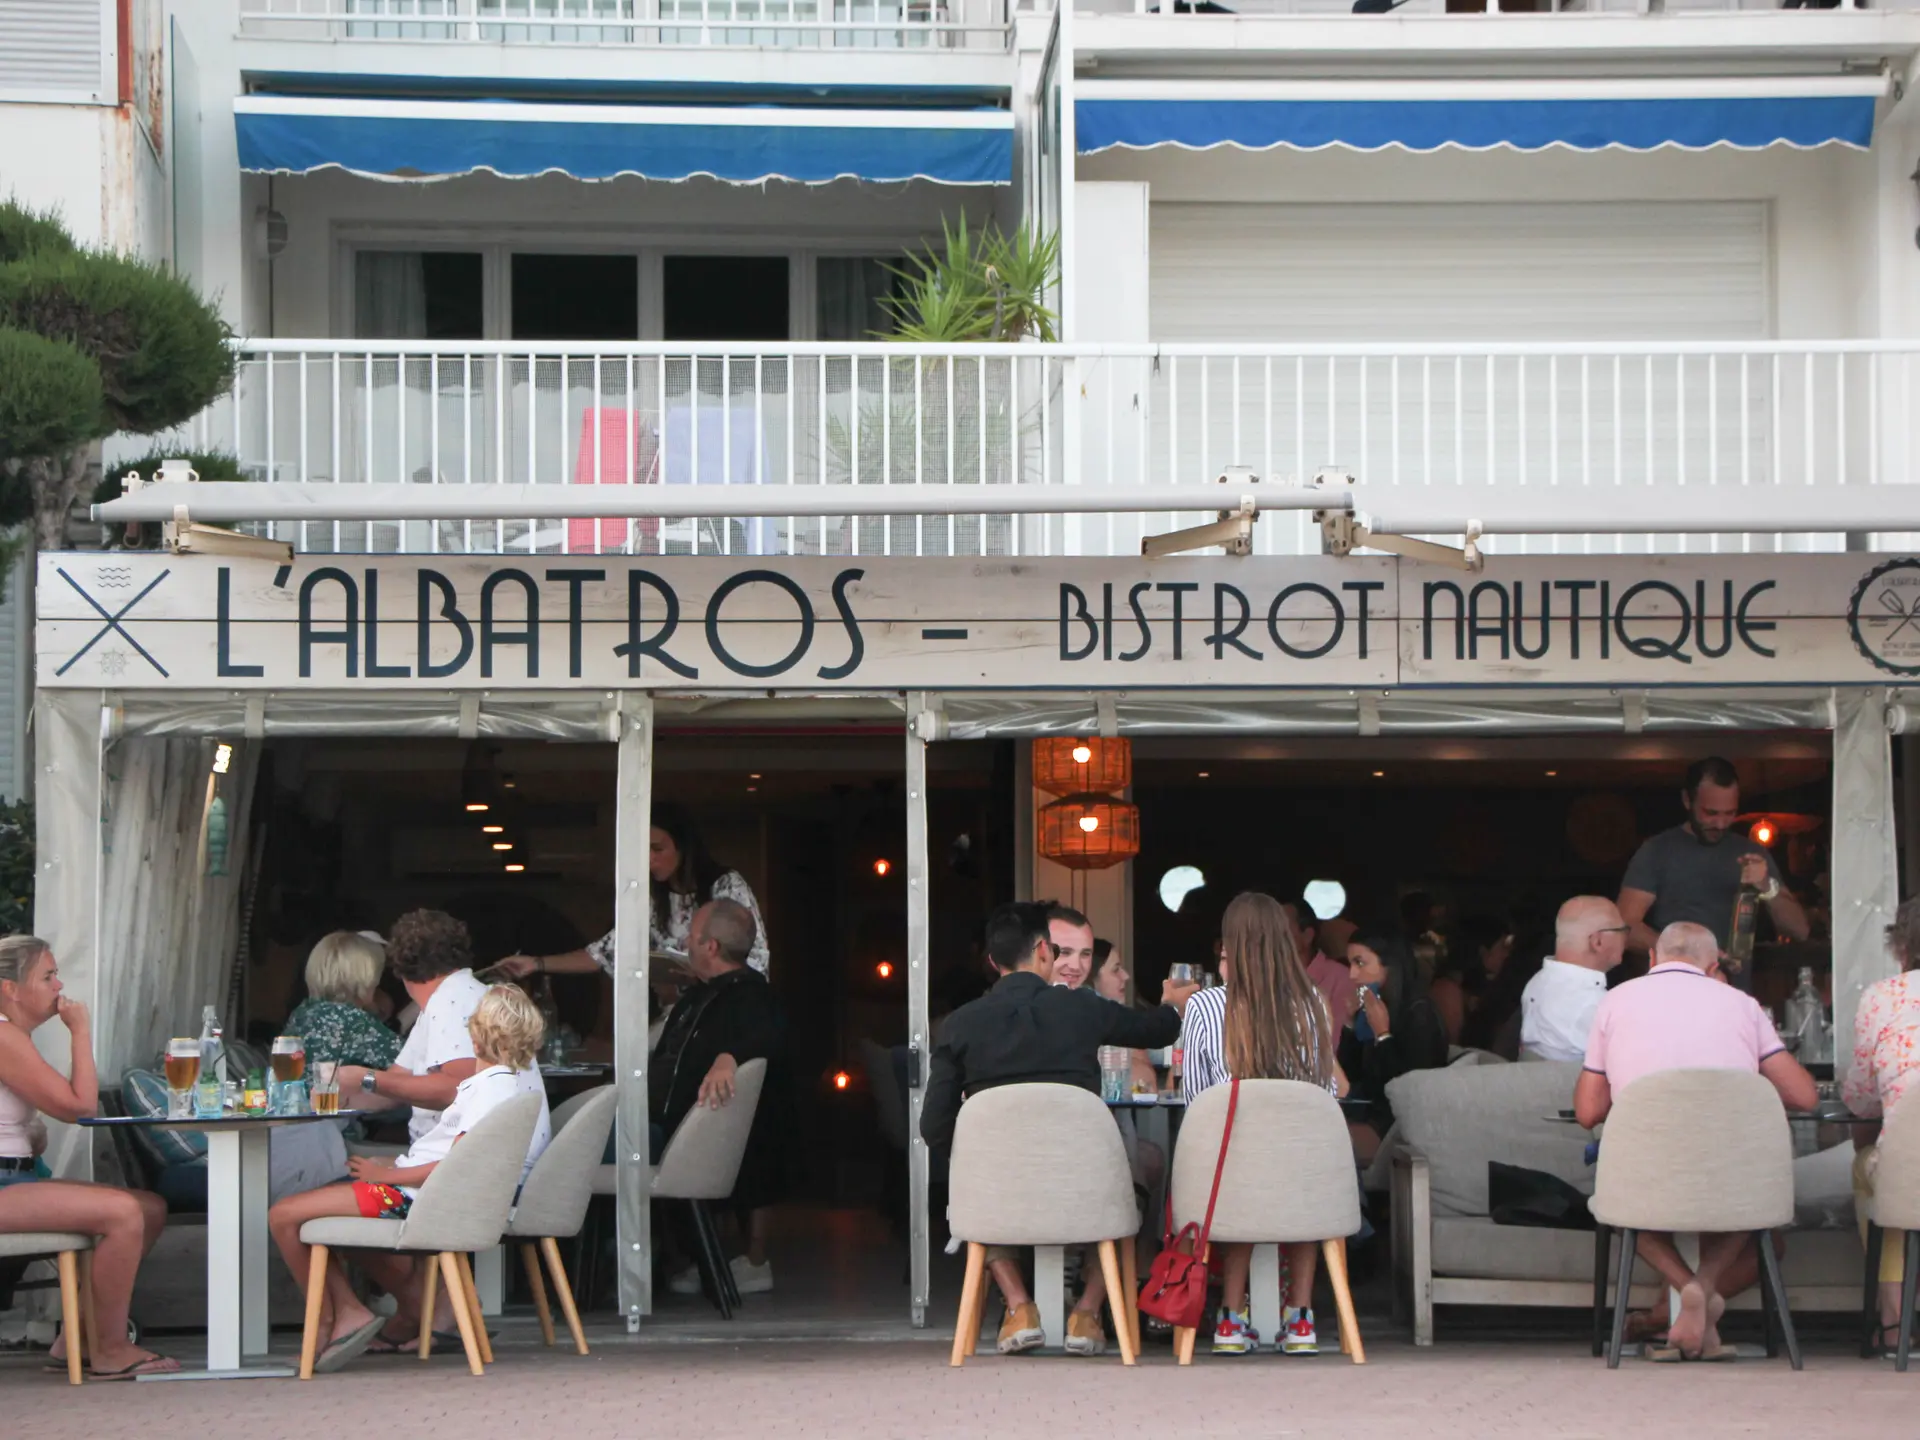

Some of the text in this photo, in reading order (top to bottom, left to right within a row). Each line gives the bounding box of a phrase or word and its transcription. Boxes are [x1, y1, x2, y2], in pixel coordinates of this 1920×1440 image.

[217, 565, 865, 680] L'ALBATROS
[1059, 581, 1385, 662] BISTROT
[1422, 579, 1777, 664] NAUTIQUE
